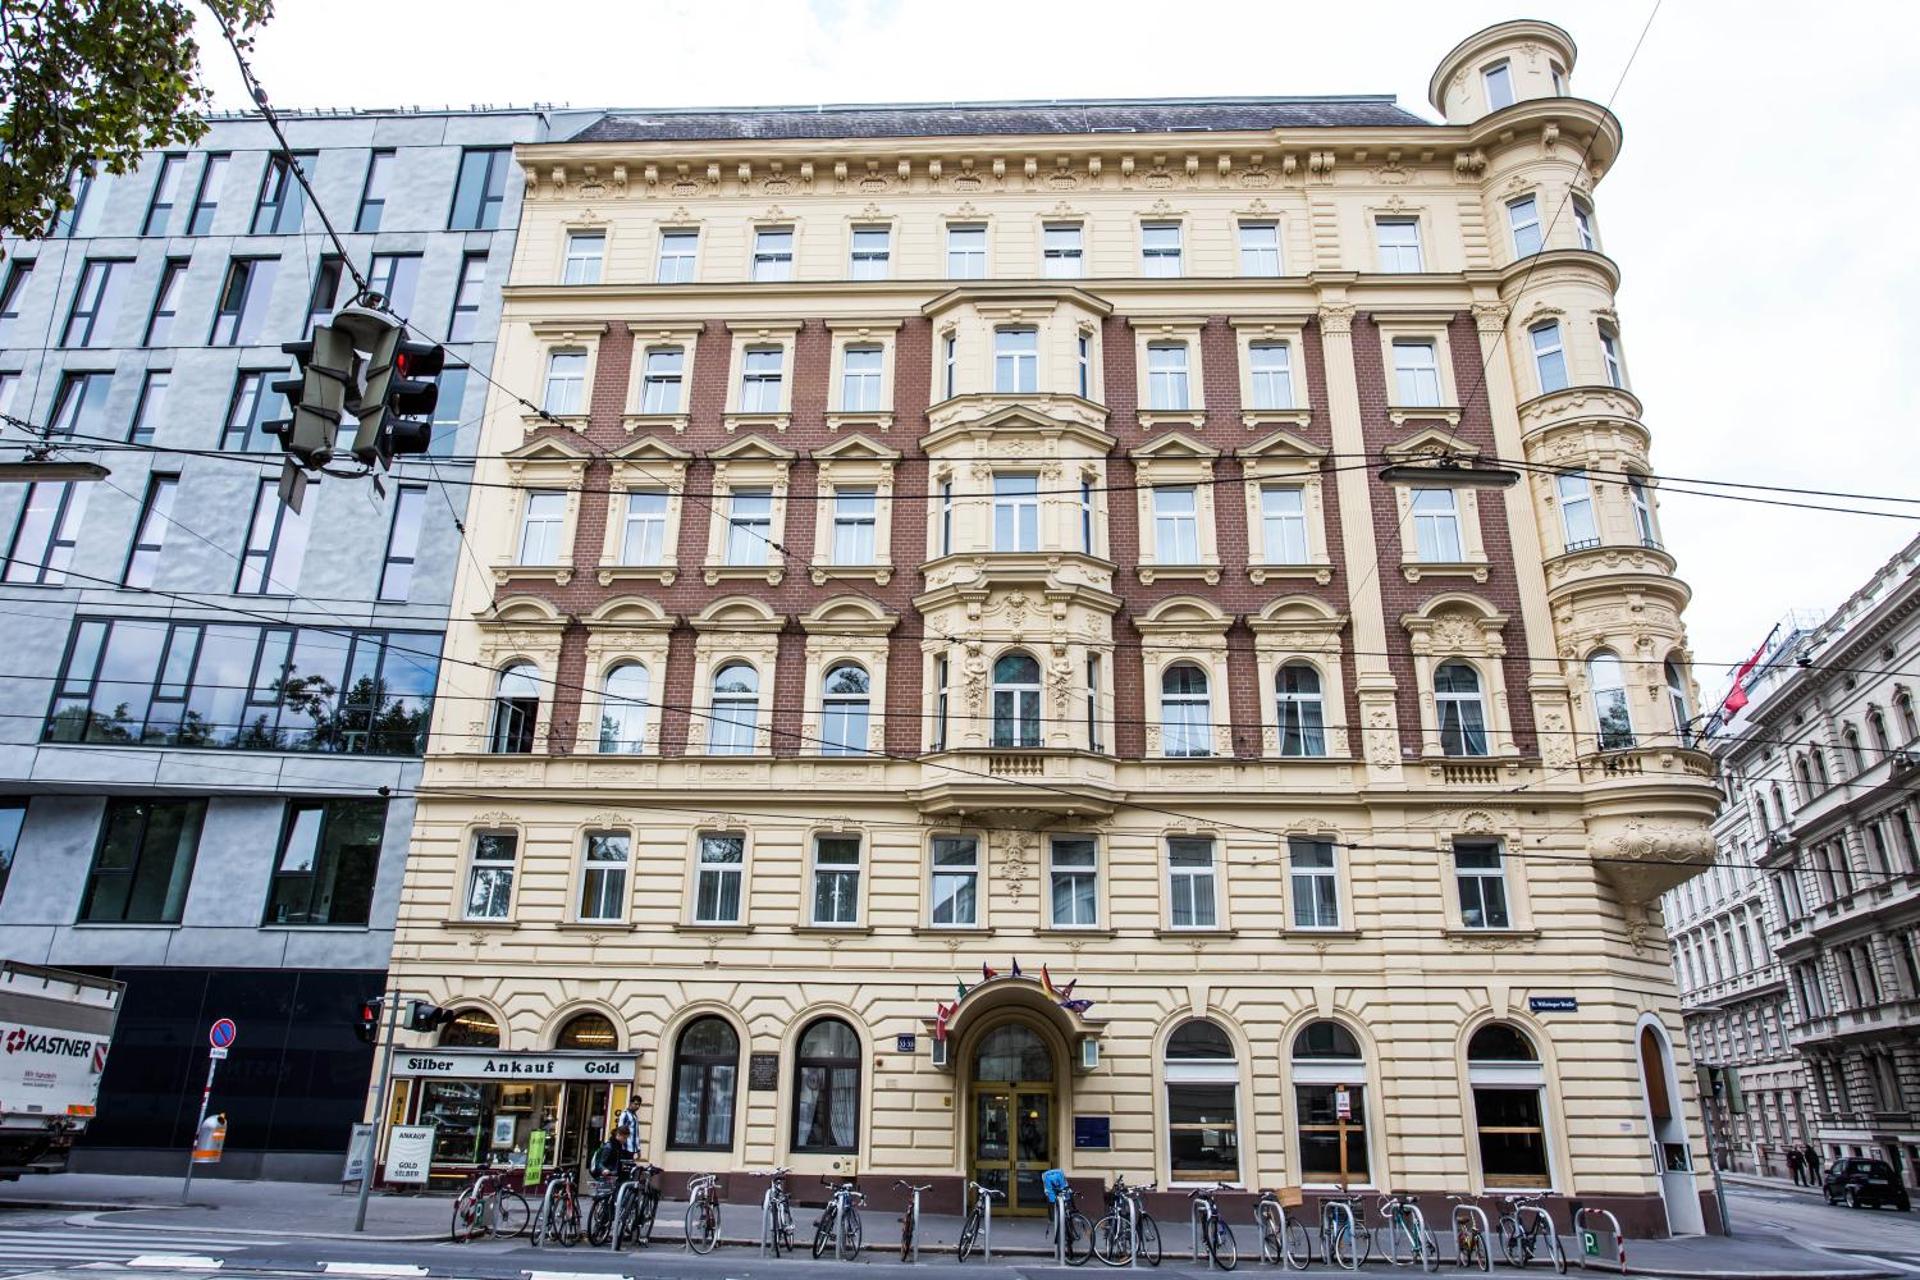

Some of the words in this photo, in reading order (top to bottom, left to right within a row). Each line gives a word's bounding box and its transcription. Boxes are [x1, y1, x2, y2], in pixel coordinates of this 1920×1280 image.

[24, 1033, 91, 1057] KASTNER
[407, 1058, 454, 1071] Silber
[483, 1060, 555, 1073] Ankauf
[584, 1061, 620, 1074] Gold
[399, 1132, 426, 1140] ANKAUF
[398, 1161, 418, 1169] GOLD
[394, 1170, 420, 1178] SILBER
[1584, 1233, 1595, 1253] P
